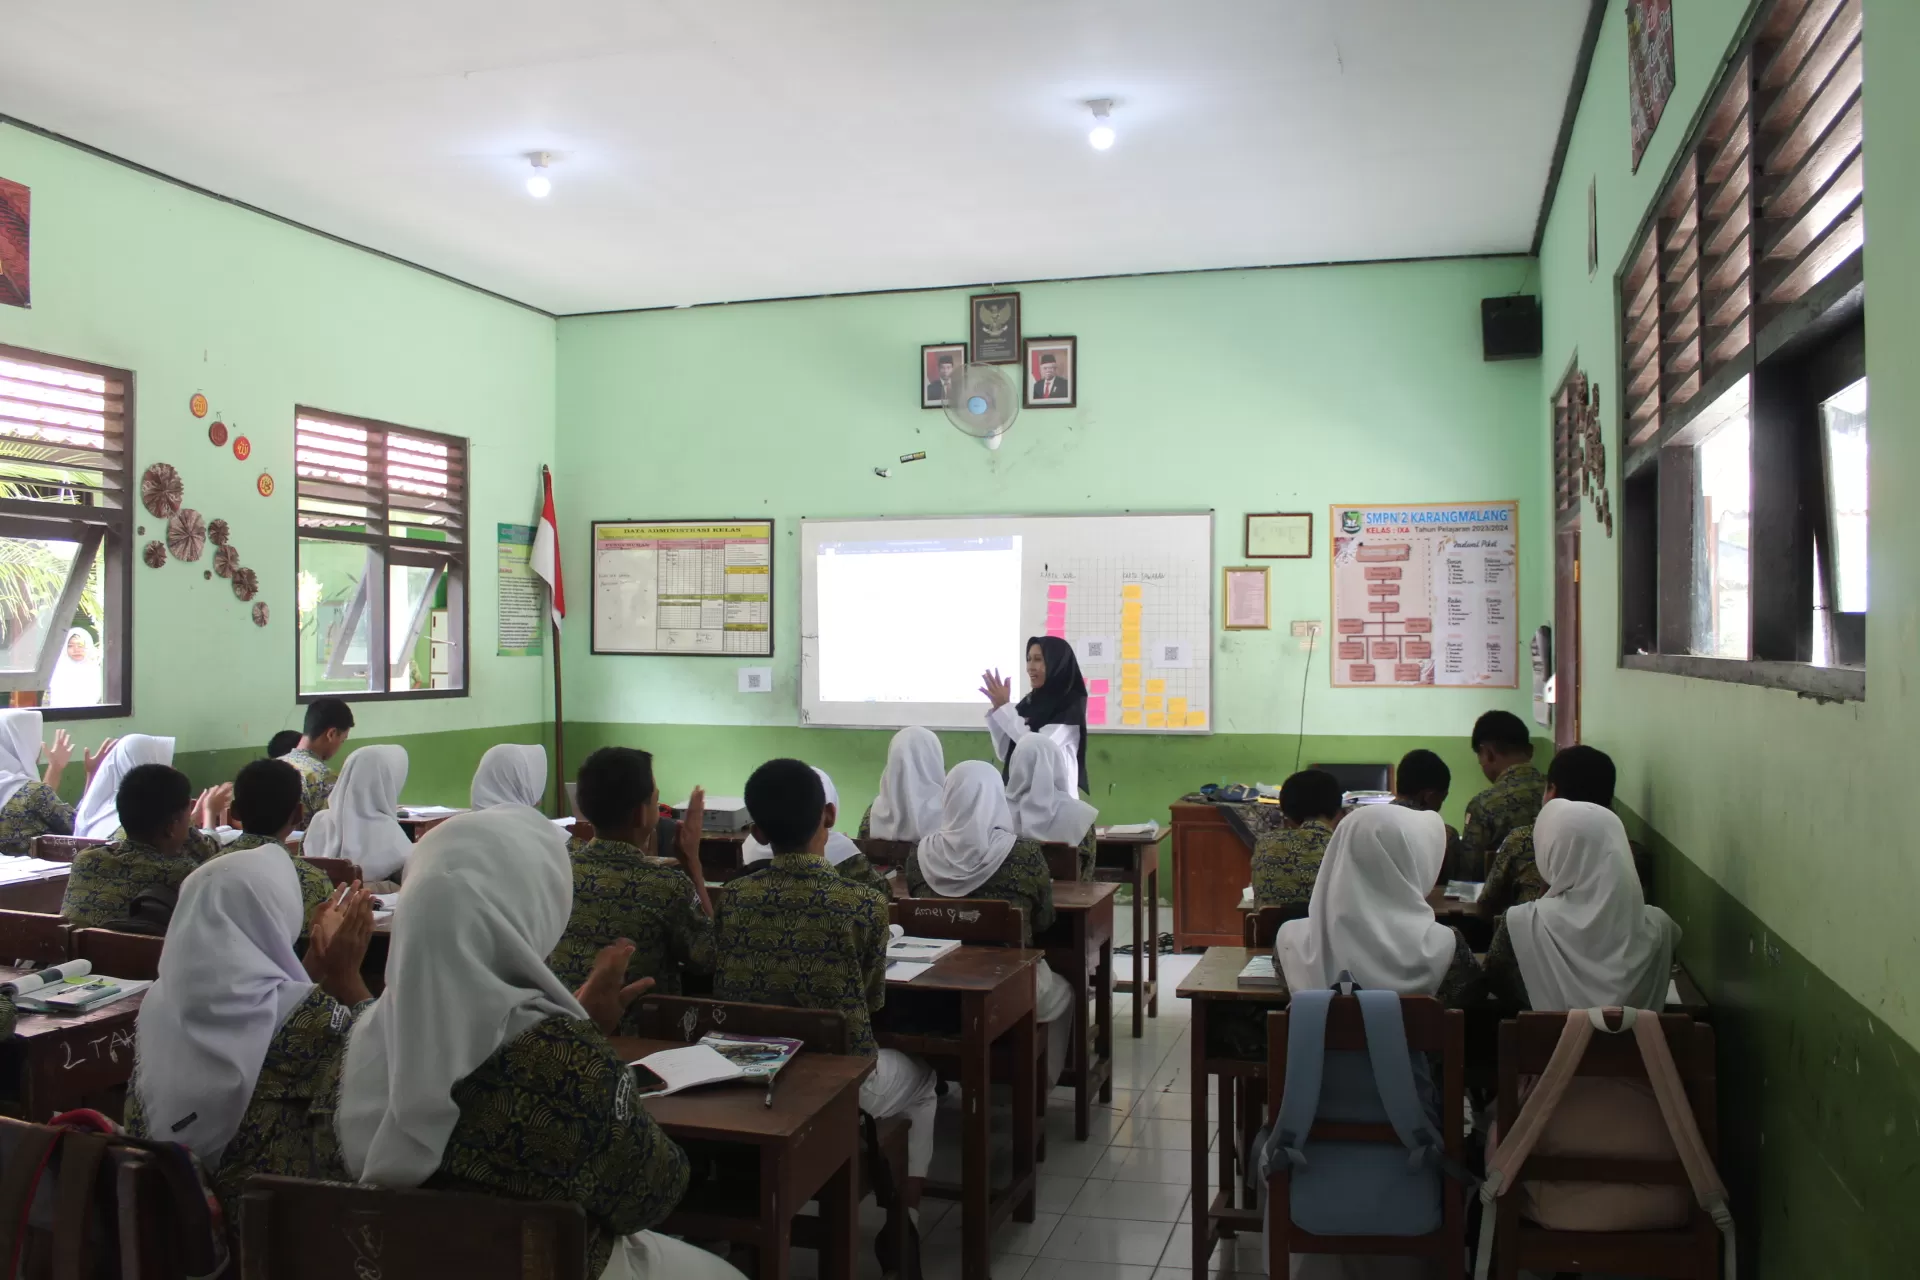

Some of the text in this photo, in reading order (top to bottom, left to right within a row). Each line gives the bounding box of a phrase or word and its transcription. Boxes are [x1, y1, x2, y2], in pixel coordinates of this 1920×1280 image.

[1366, 509, 1508, 525] SMPN 2 KARANGMALANG
[1366, 526, 1392, 534] KELAS
[1397, 526, 1410, 534] IXA
[1415, 524, 1509, 534] Tahun Pelajaran 2023/2024
